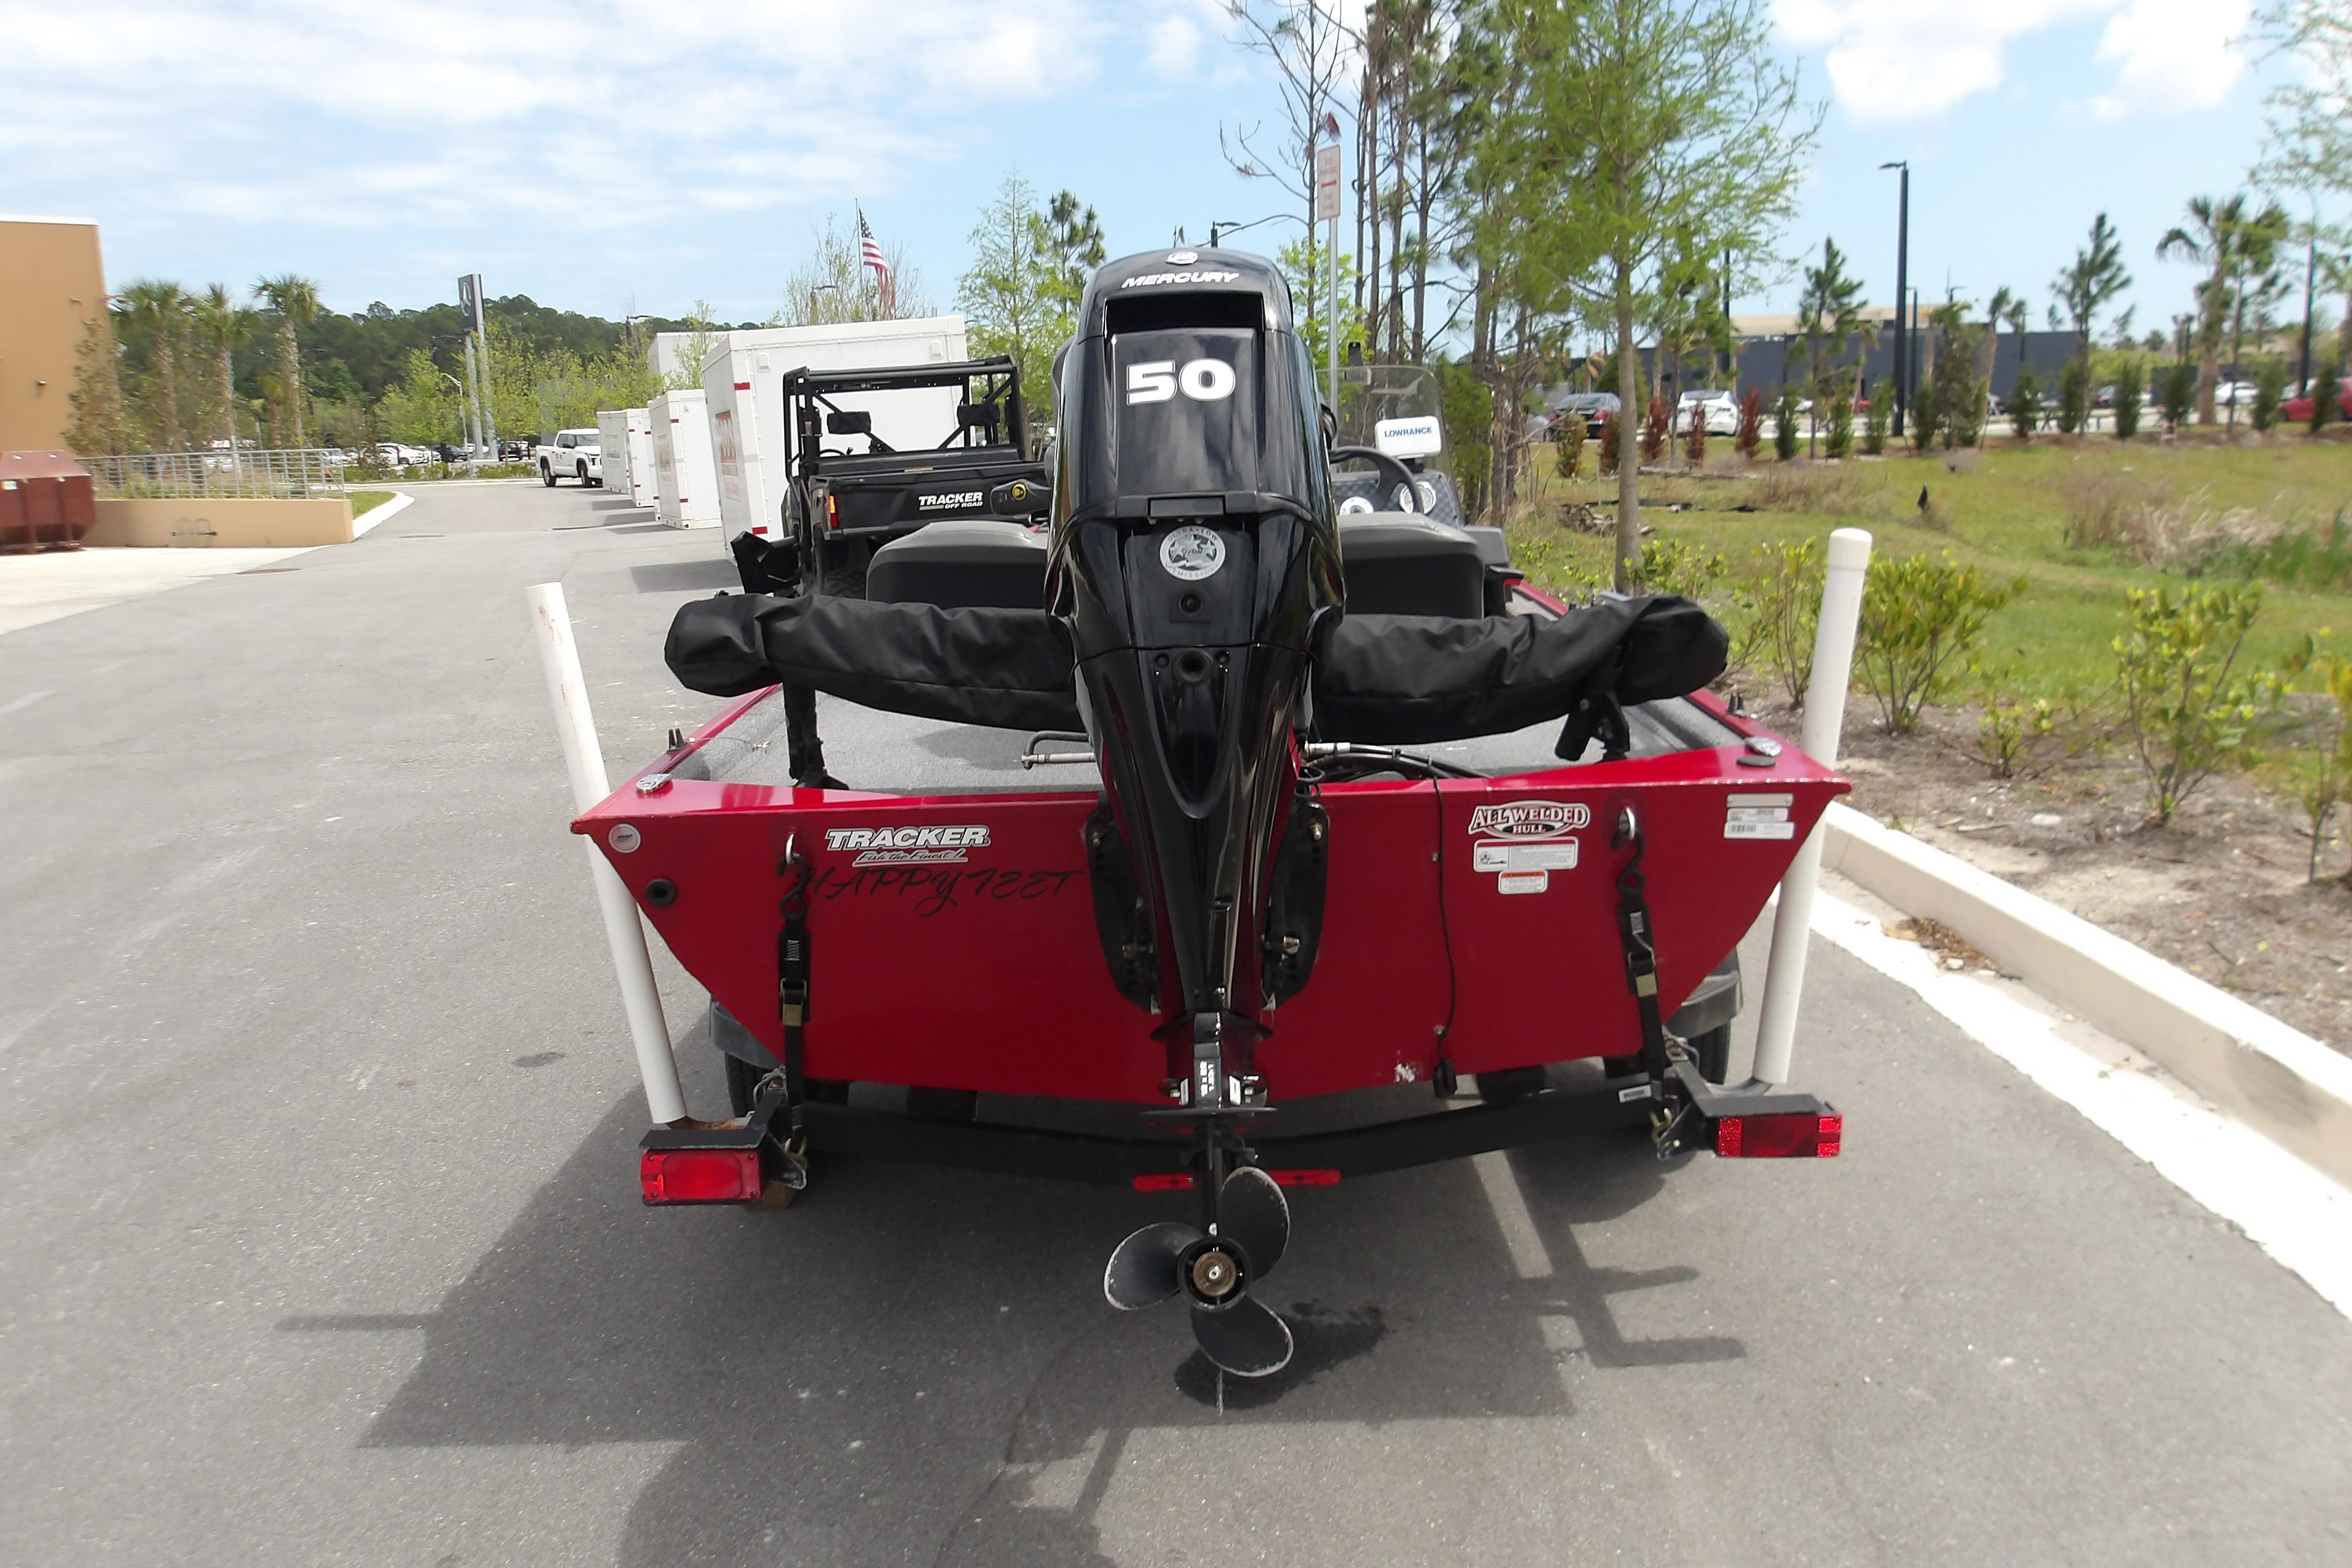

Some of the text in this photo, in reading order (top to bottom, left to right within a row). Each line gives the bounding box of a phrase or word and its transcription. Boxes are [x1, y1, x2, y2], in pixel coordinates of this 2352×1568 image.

[1121, 272, 1239, 289] MERCURY
[1126, 359, 1235, 406] 50
[1384, 427, 1432, 437] LOWRANCE
[918, 492, 983, 505] TRACKER
[1472, 806, 1588, 829] ALL WELDED
[1512, 824, 1547, 834] HULL
[828, 827, 987, 849] TRACKER
[858, 852, 886, 861] Fish
[888, 851, 908, 860] the
